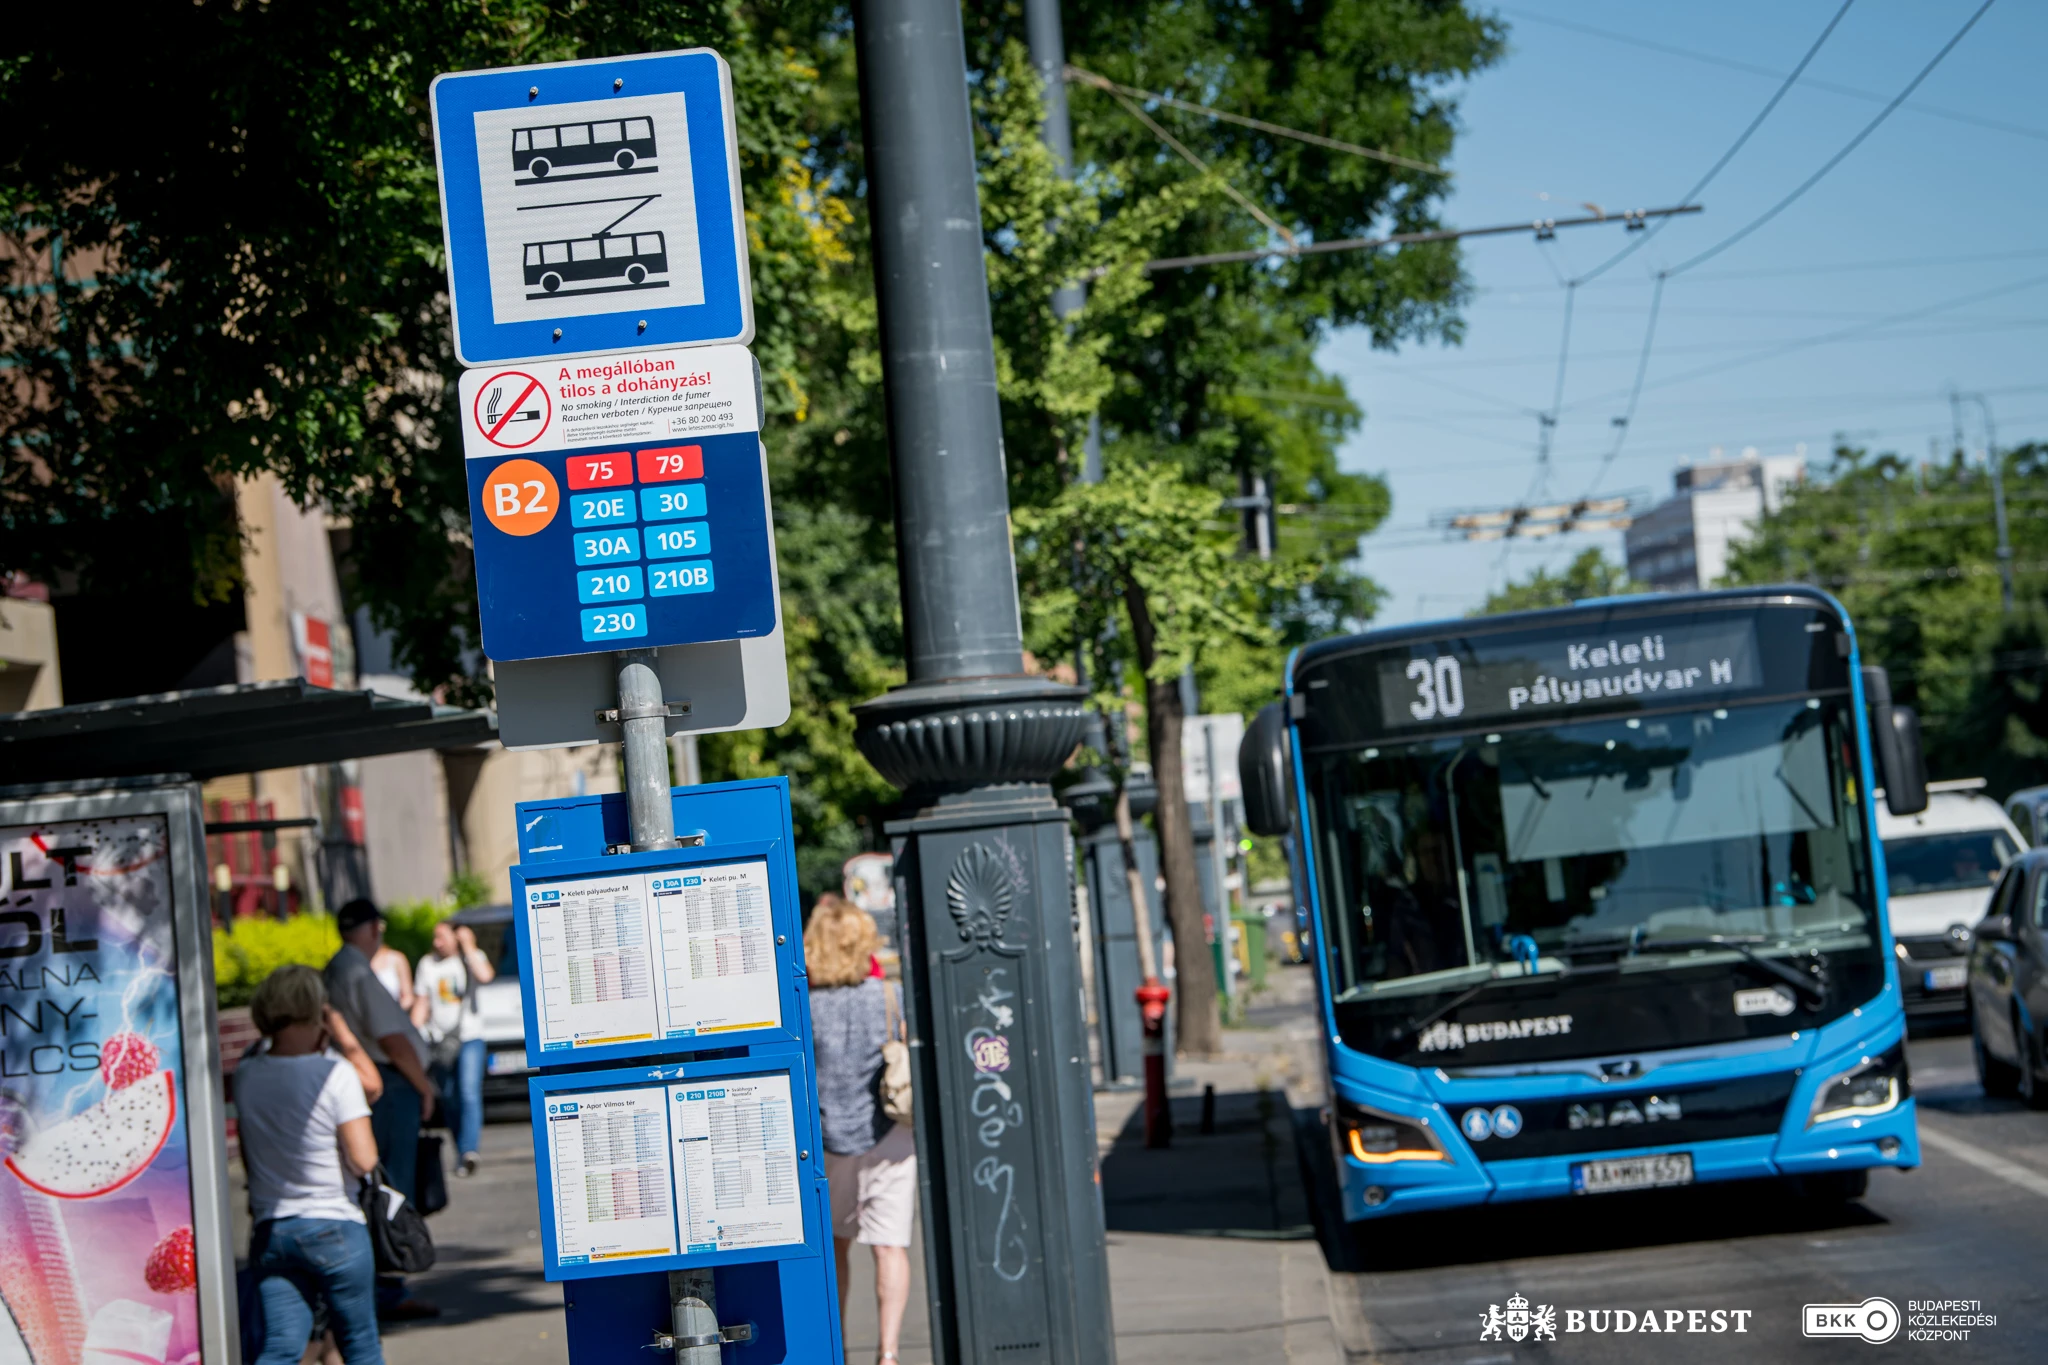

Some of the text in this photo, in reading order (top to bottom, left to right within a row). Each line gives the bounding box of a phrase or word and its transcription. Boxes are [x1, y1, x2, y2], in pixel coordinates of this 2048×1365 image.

[558, 359, 675, 380] A megállóban
[560, 372, 712, 398] tilos a dohányzás!
[561, 403, 574, 412] No
[576, 399, 612, 412] smoking
[620, 394, 670, 406] Interdiction
[672, 393, 683, 402] de
[684, 391, 711, 402] fumer
[562, 412, 599, 423] Rauchen
[601, 408, 639, 419] verboten
[648, 404, 683, 415] Курение
[684, 400, 732, 412] запрещено
[672, 417, 686, 425] +36
[702, 414, 716, 422] 200
[719, 413, 734, 421] 493
[586, 454, 684, 481] 75 79
[494, 480, 548, 517] B2
[582, 492, 688, 520] 20E 30
[584, 530, 697, 558] 30A 105
[591, 568, 709, 595] 210 210B
[593, 613, 636, 634] 230
[1567, 635, 1665, 670] Keleti
[1406, 655, 1465, 721] 30
[1508, 658, 1732, 710] pályaudvar M
[0, 846, 92, 890] LT
[587, 887, 620, 896] pályaudvar
[1466, 1015, 1573, 1043] BUDAPEST
[1568, 1095, 1682, 1130] MAN
[1588, 1164, 1612, 1183] AA
